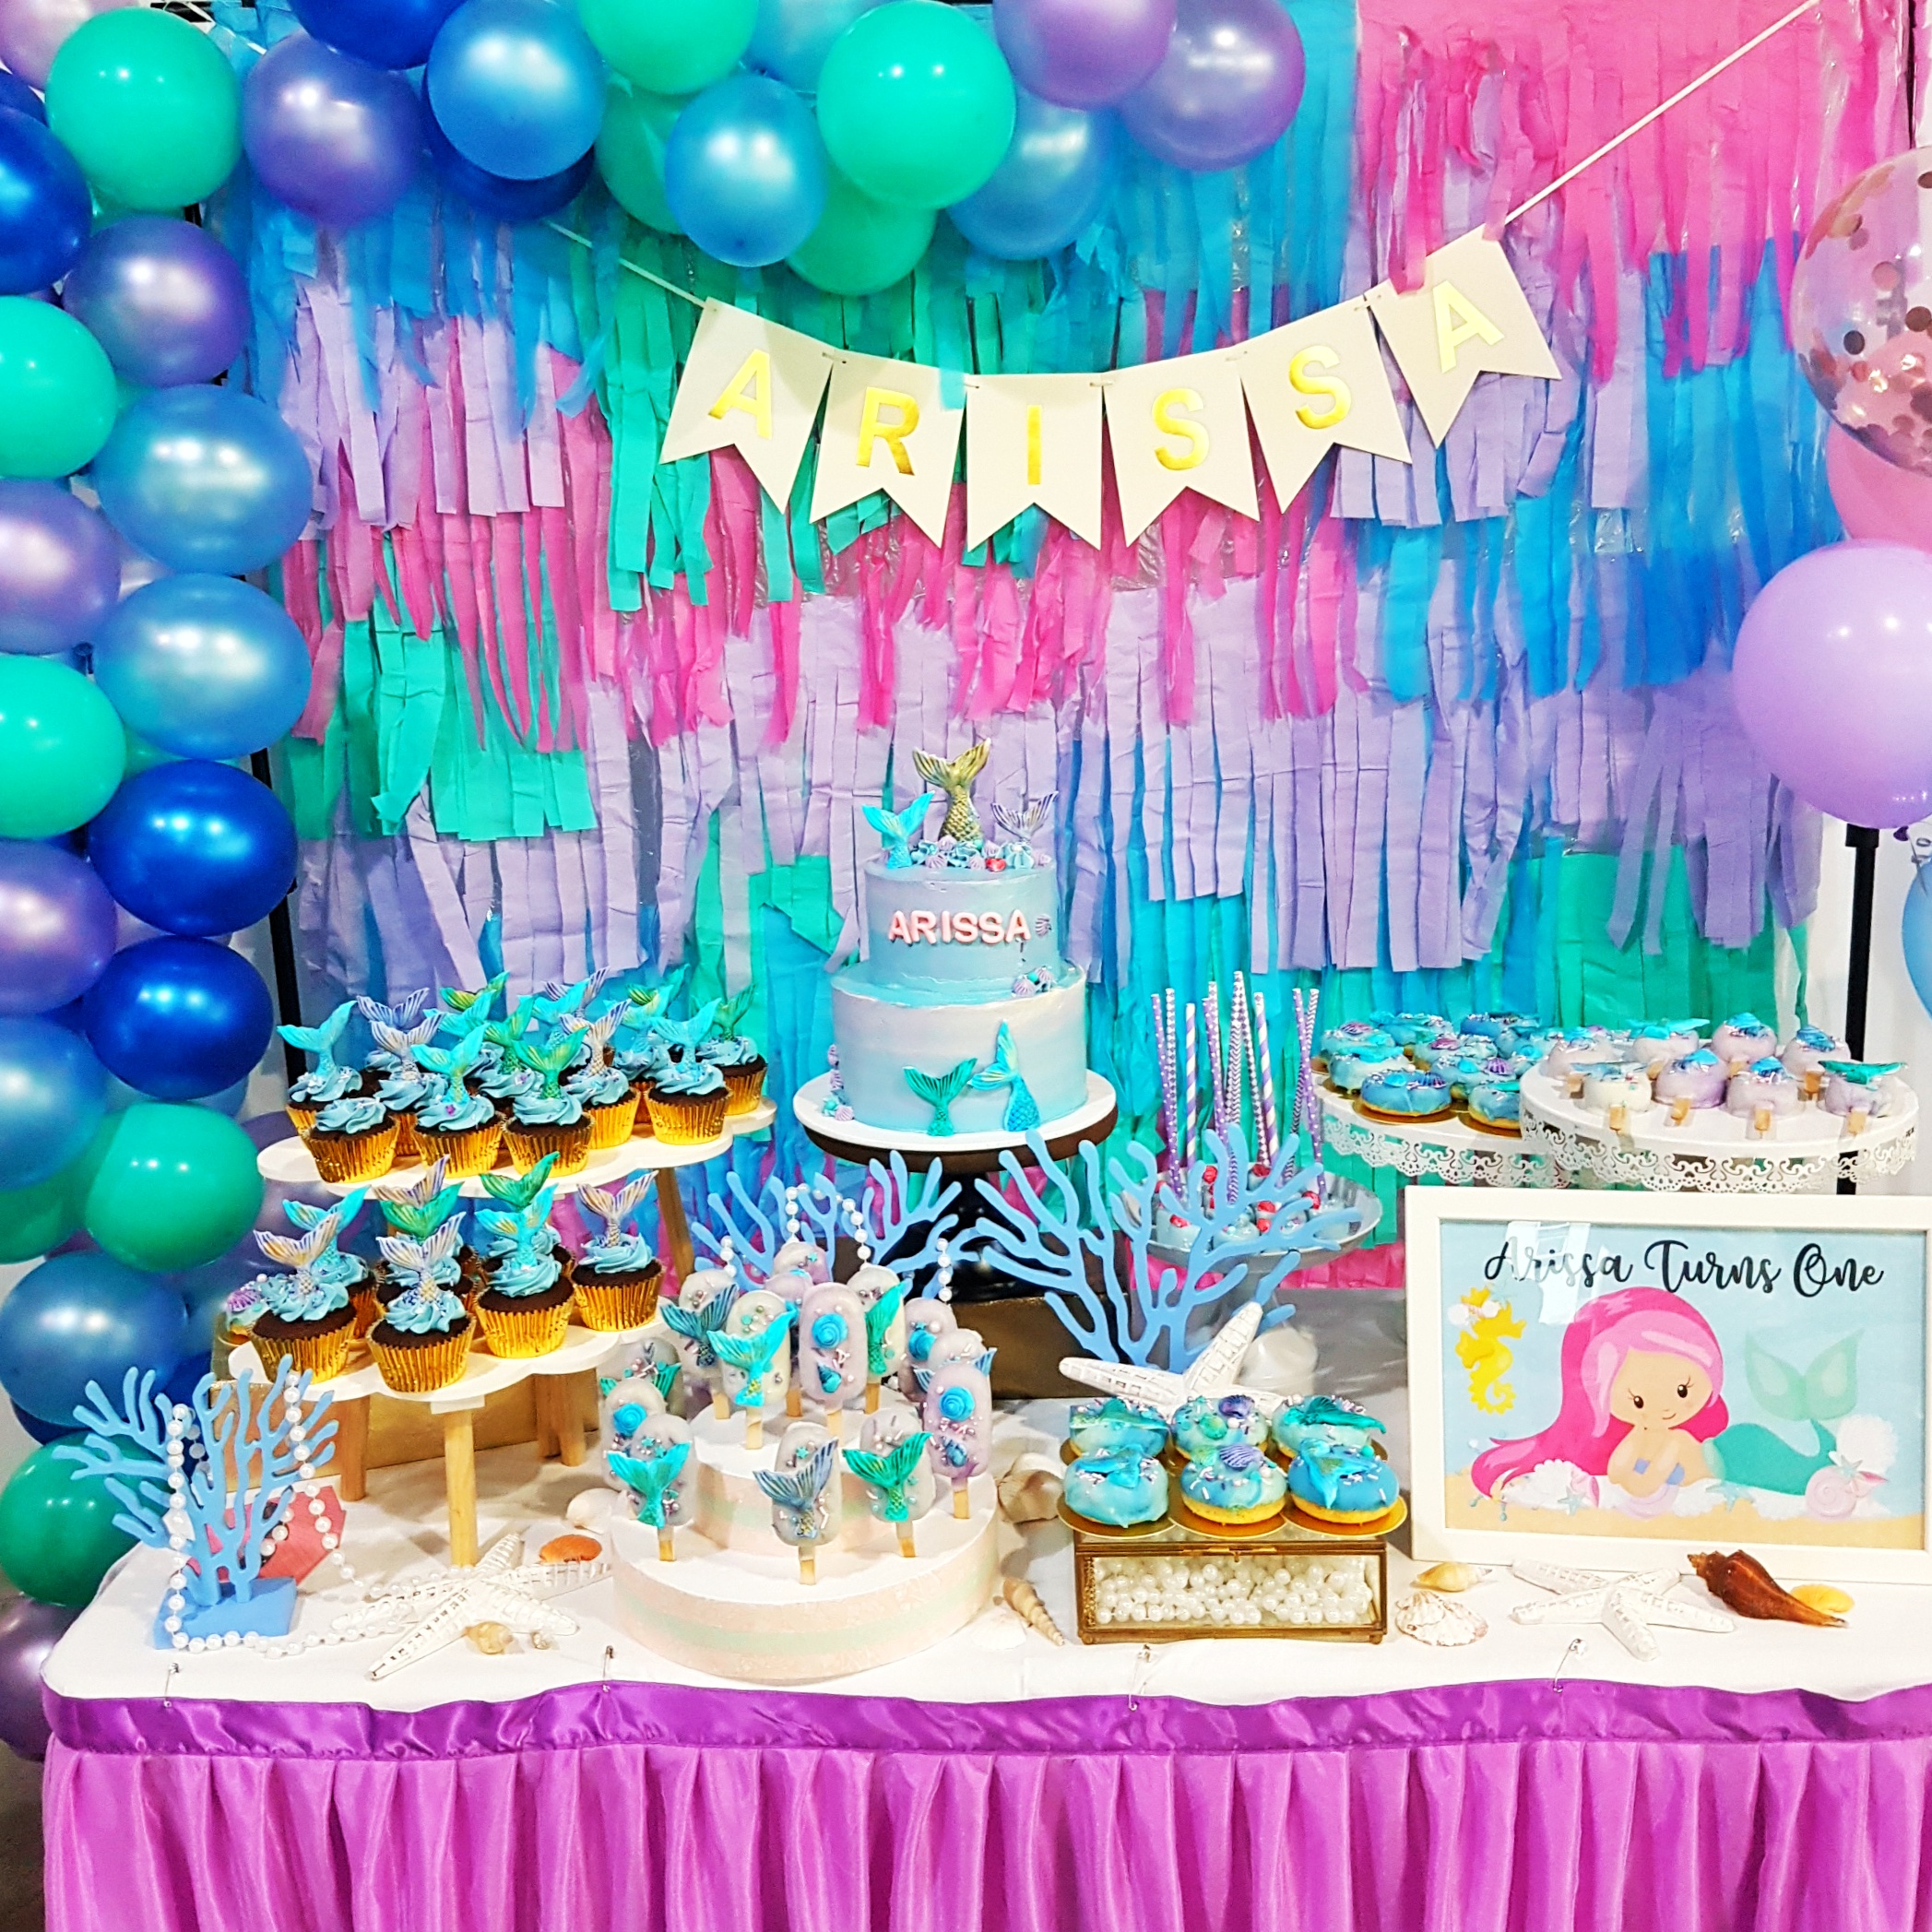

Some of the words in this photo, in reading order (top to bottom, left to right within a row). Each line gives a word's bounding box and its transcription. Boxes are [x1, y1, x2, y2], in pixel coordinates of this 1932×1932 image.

[707, 279, 1504, 486] ARISSA
[888, 908, 1031, 945] ARISSA
[1484, 1236, 1634, 1288] Arissa
[1643, 1239, 1782, 1293] Turns
[1793, 1242, 1884, 1298] One
